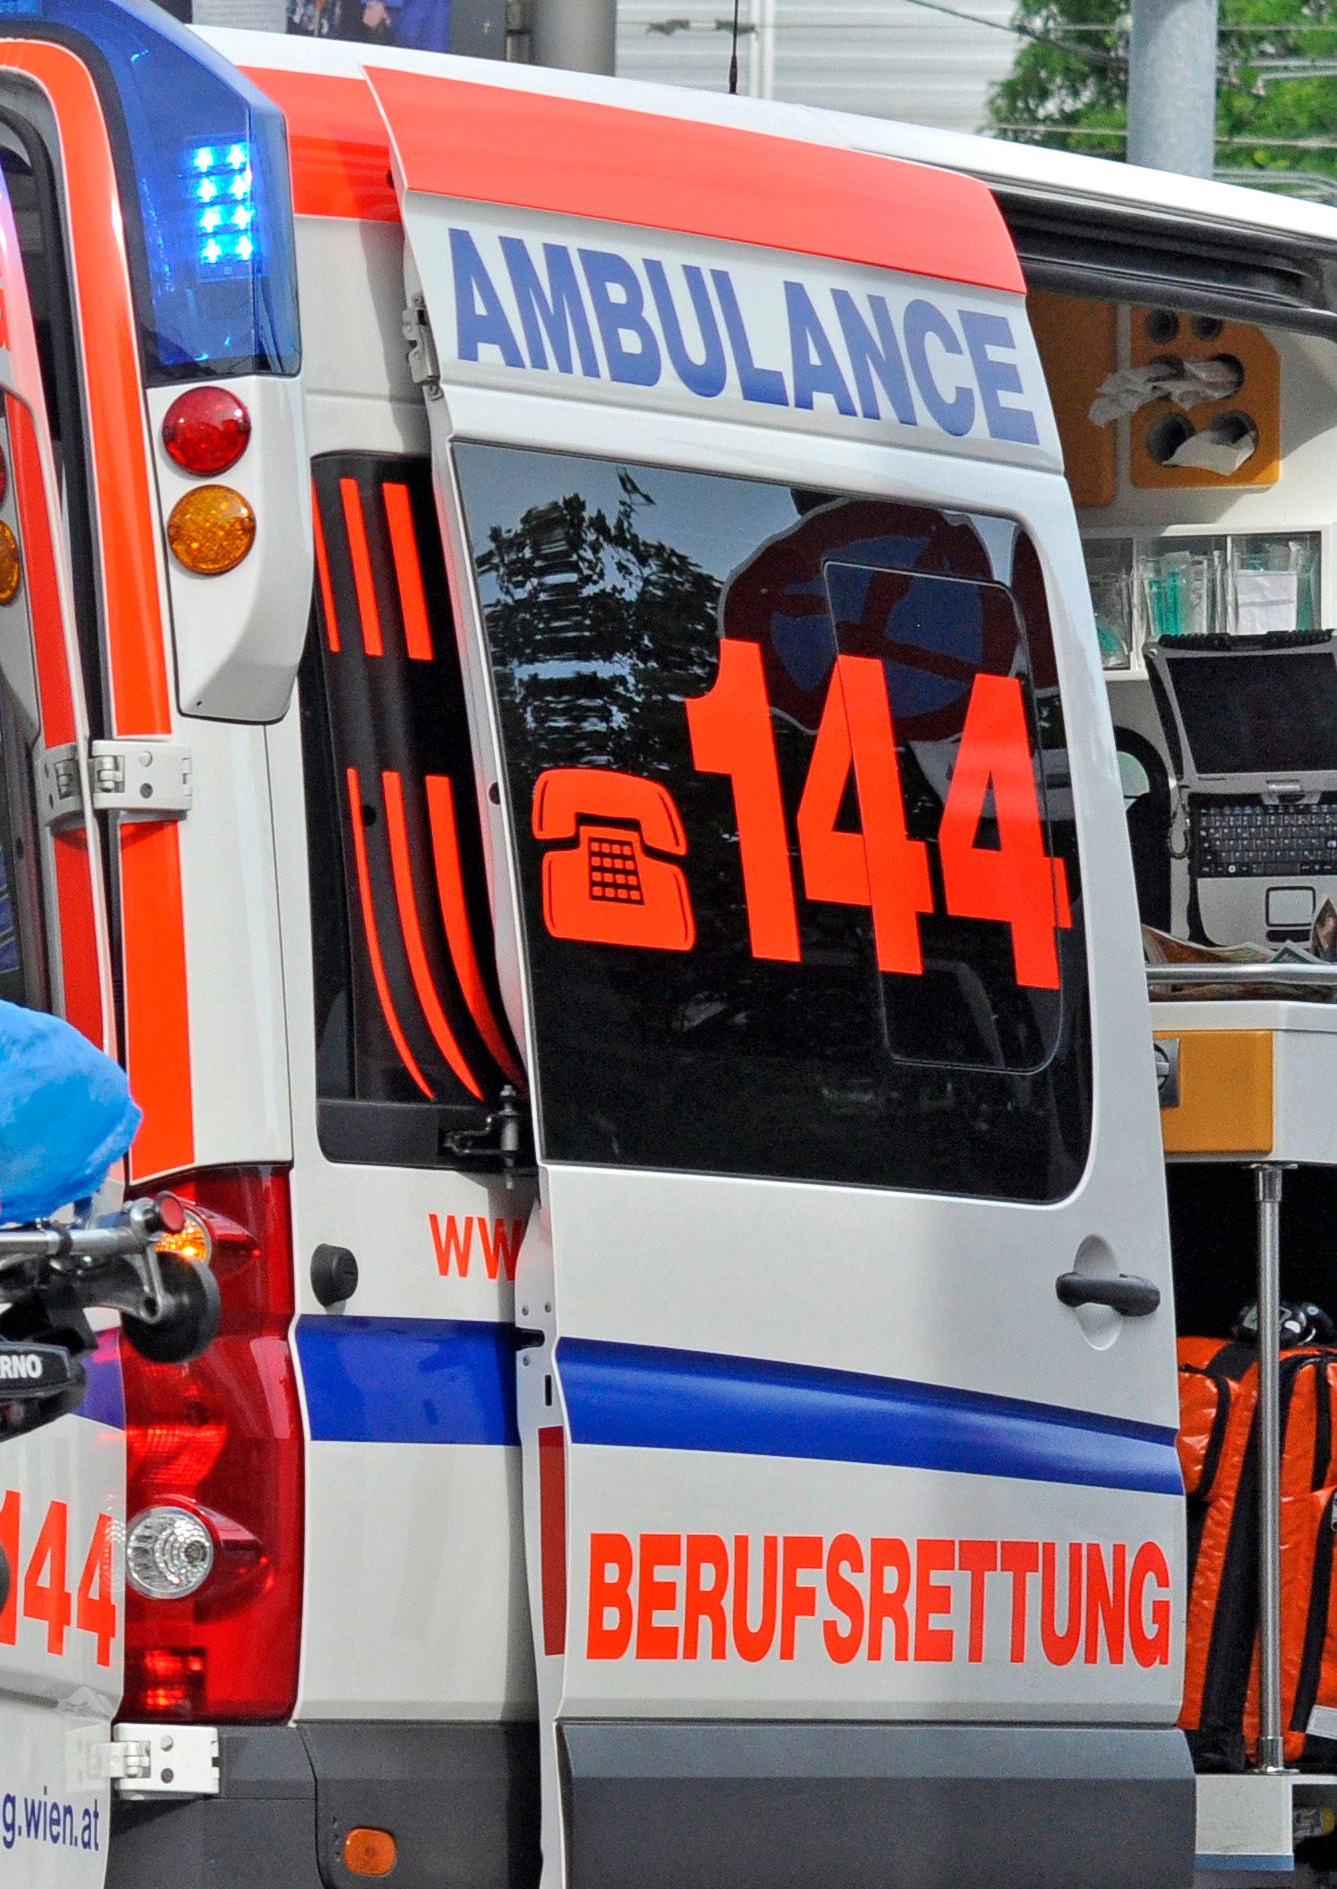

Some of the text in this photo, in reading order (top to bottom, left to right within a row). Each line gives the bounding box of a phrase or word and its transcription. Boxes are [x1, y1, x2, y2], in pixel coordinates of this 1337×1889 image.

[450, 228, 1038, 444] AMBULANCE
[684, 636, 1072, 990] 144
[586, 1533, 1171, 1668] BERUFSRETTUNG
